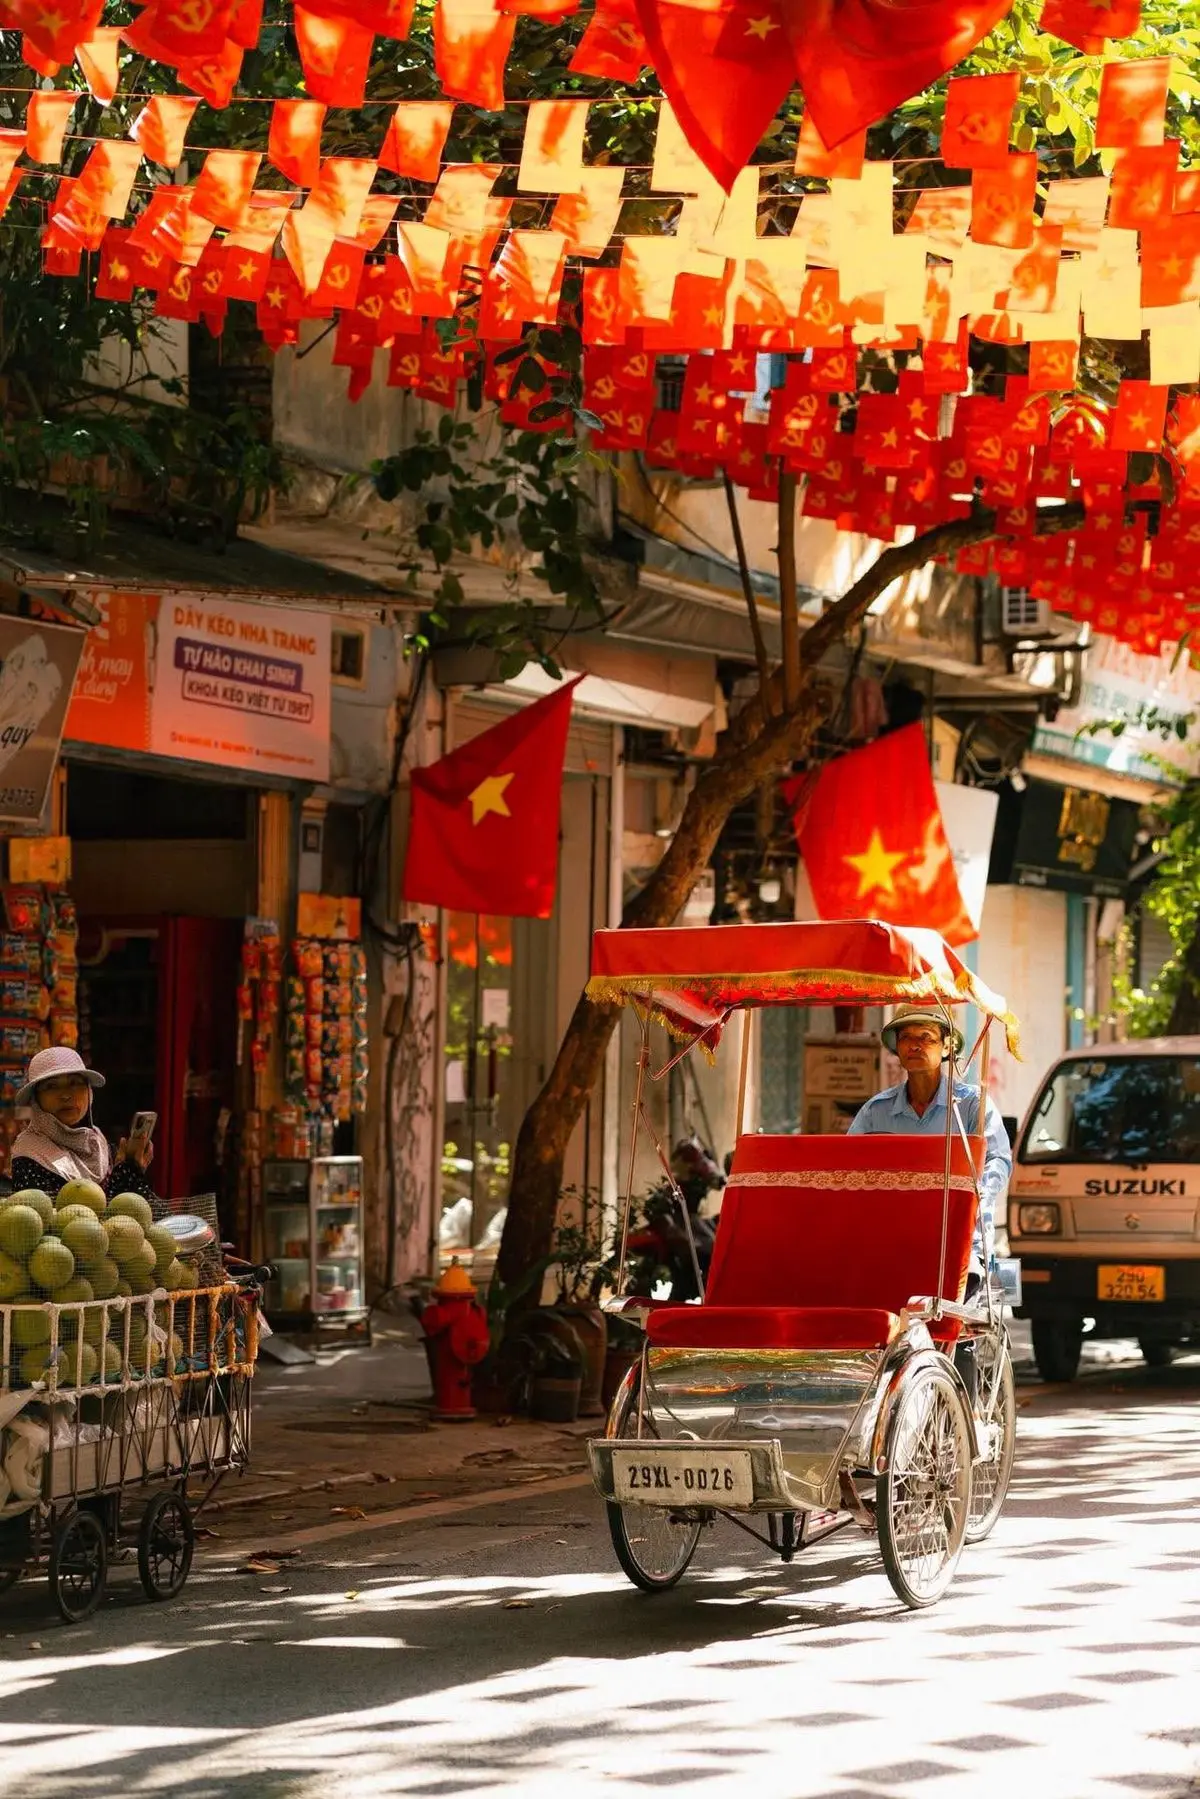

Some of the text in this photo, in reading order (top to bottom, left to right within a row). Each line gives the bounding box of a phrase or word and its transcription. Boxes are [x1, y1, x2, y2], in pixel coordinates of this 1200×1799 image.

[207, 613, 236, 637] KÉO
[239, 621, 268, 644] NHA
[272, 629, 317, 655] TRANG
[183, 645, 297, 687] TỰ HÀO KHAI SINH
[222, 684, 244, 704] KÉO
[1085, 1179, 1187, 1196] SUZUKI
[628, 1465, 735, 1491] 29XL-0026
